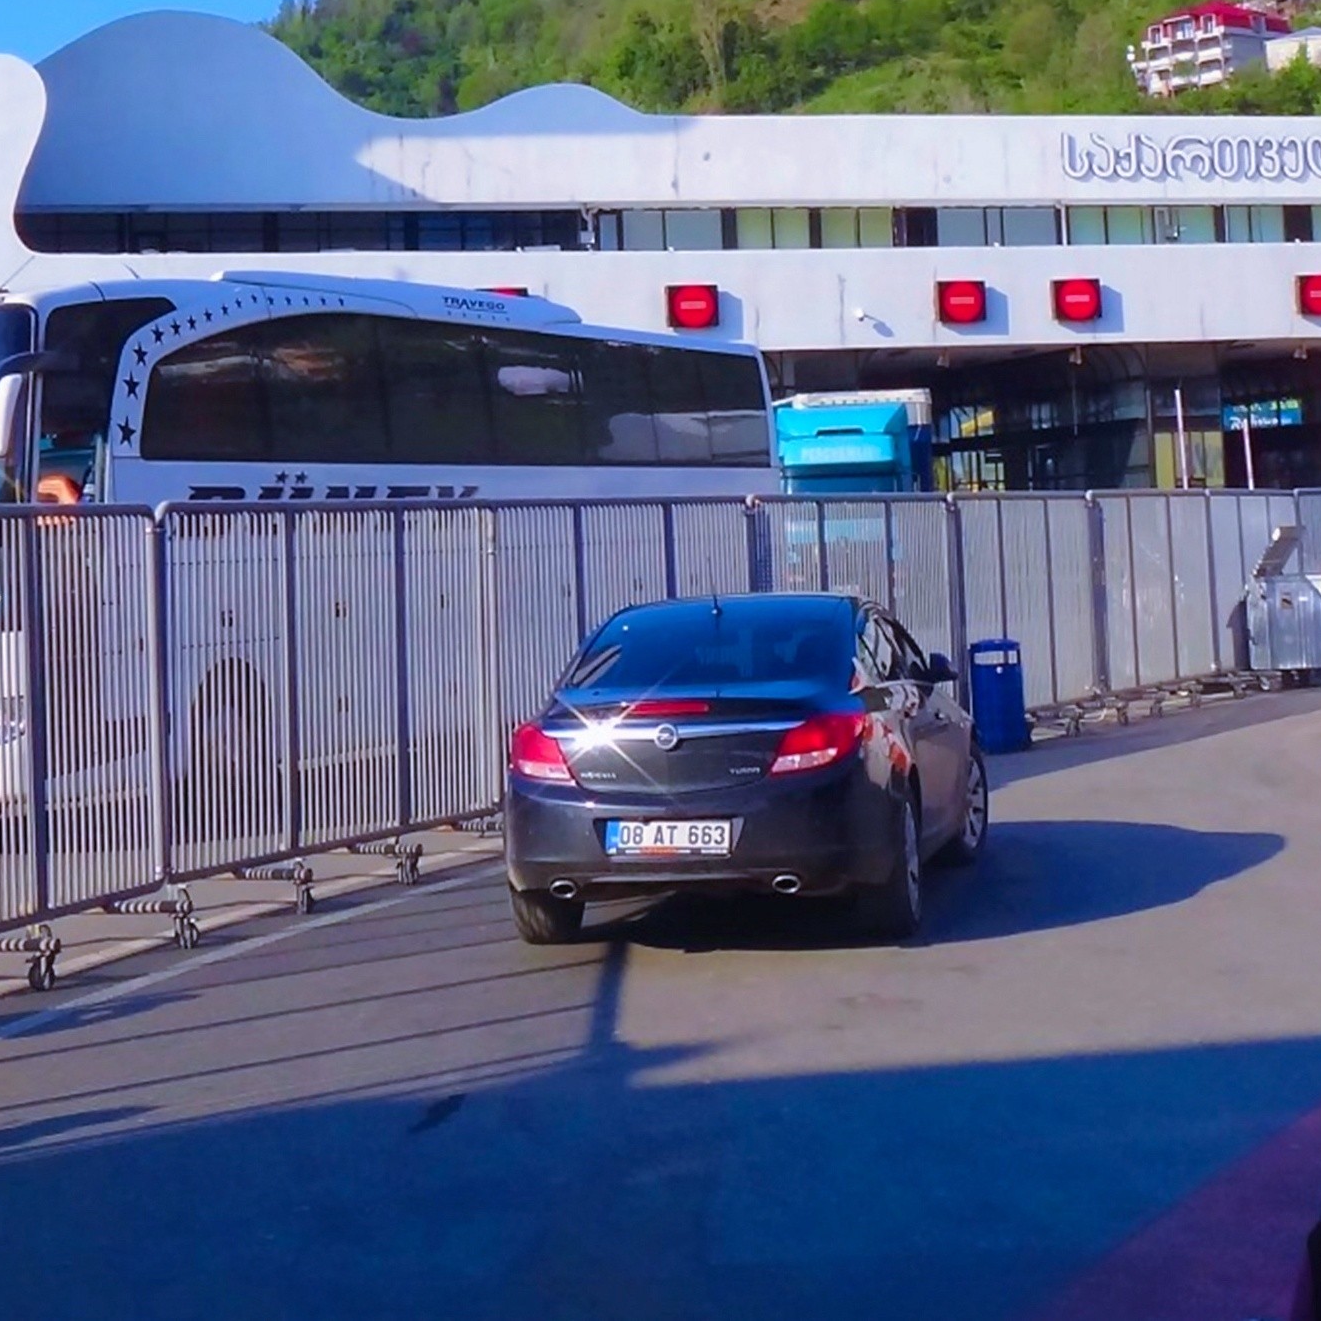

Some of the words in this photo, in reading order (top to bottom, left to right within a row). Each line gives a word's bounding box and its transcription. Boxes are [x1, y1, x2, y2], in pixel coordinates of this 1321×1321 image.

[619, 824, 644, 846] 08
[652, 824, 678, 846] AT
[687, 824, 727, 846] 663
